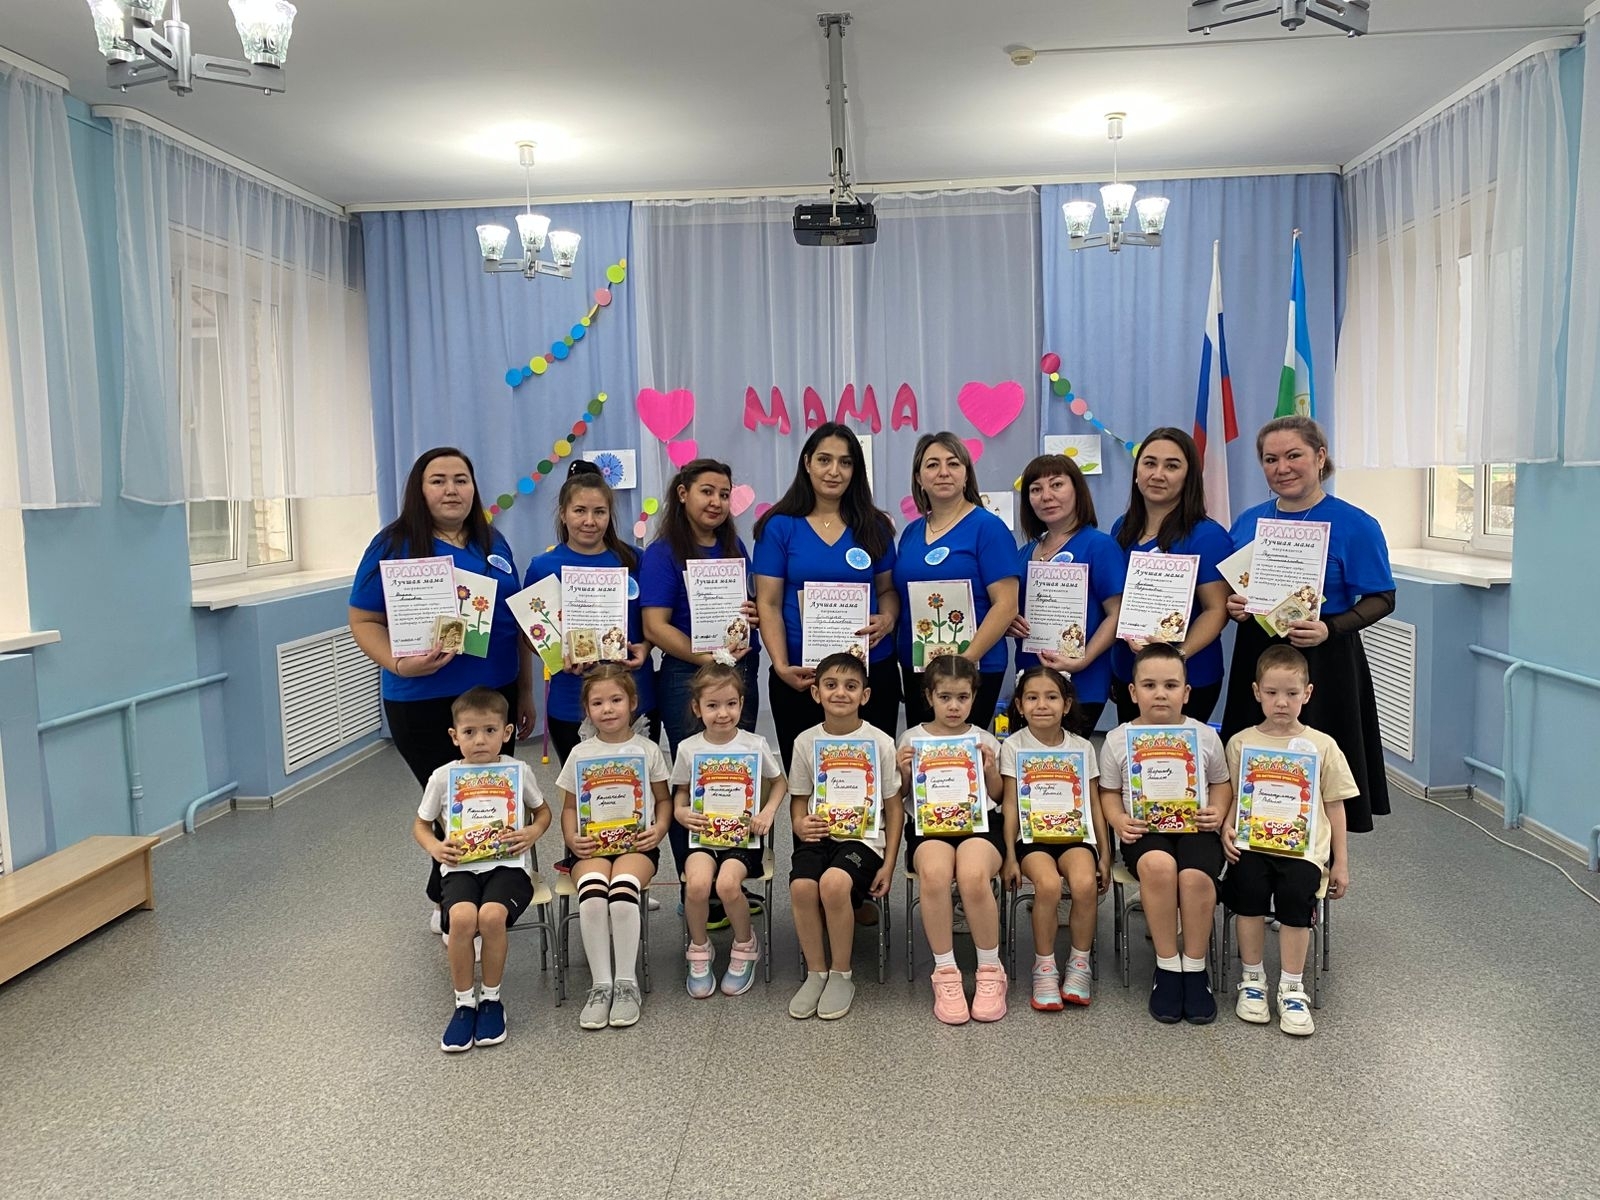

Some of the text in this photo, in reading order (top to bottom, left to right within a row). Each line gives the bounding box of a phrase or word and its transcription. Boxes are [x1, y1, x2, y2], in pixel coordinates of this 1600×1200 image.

[743, 383, 918, 435] МАМА
[1259, 526, 1321, 540] ГРАМОТА
[1261, 538, 1291, 547] Лучшая
[1132, 558, 1190, 571] ГРАМОТА
[386, 564, 448, 578] ГРАМОТА
[691, 566, 739, 577] ГРАМОТА
[1031, 568, 1082, 580] ГРАМОТА
[1134, 569, 1162, 577] Лучшая
[391, 579, 421, 587] Лучшая
[565, 573, 622, 585] ГРАМОТА
[568, 585, 595, 593] Лучшая
[807, 589, 863, 600] ГРАМОТА
[810, 601, 837, 609] Лучшая
